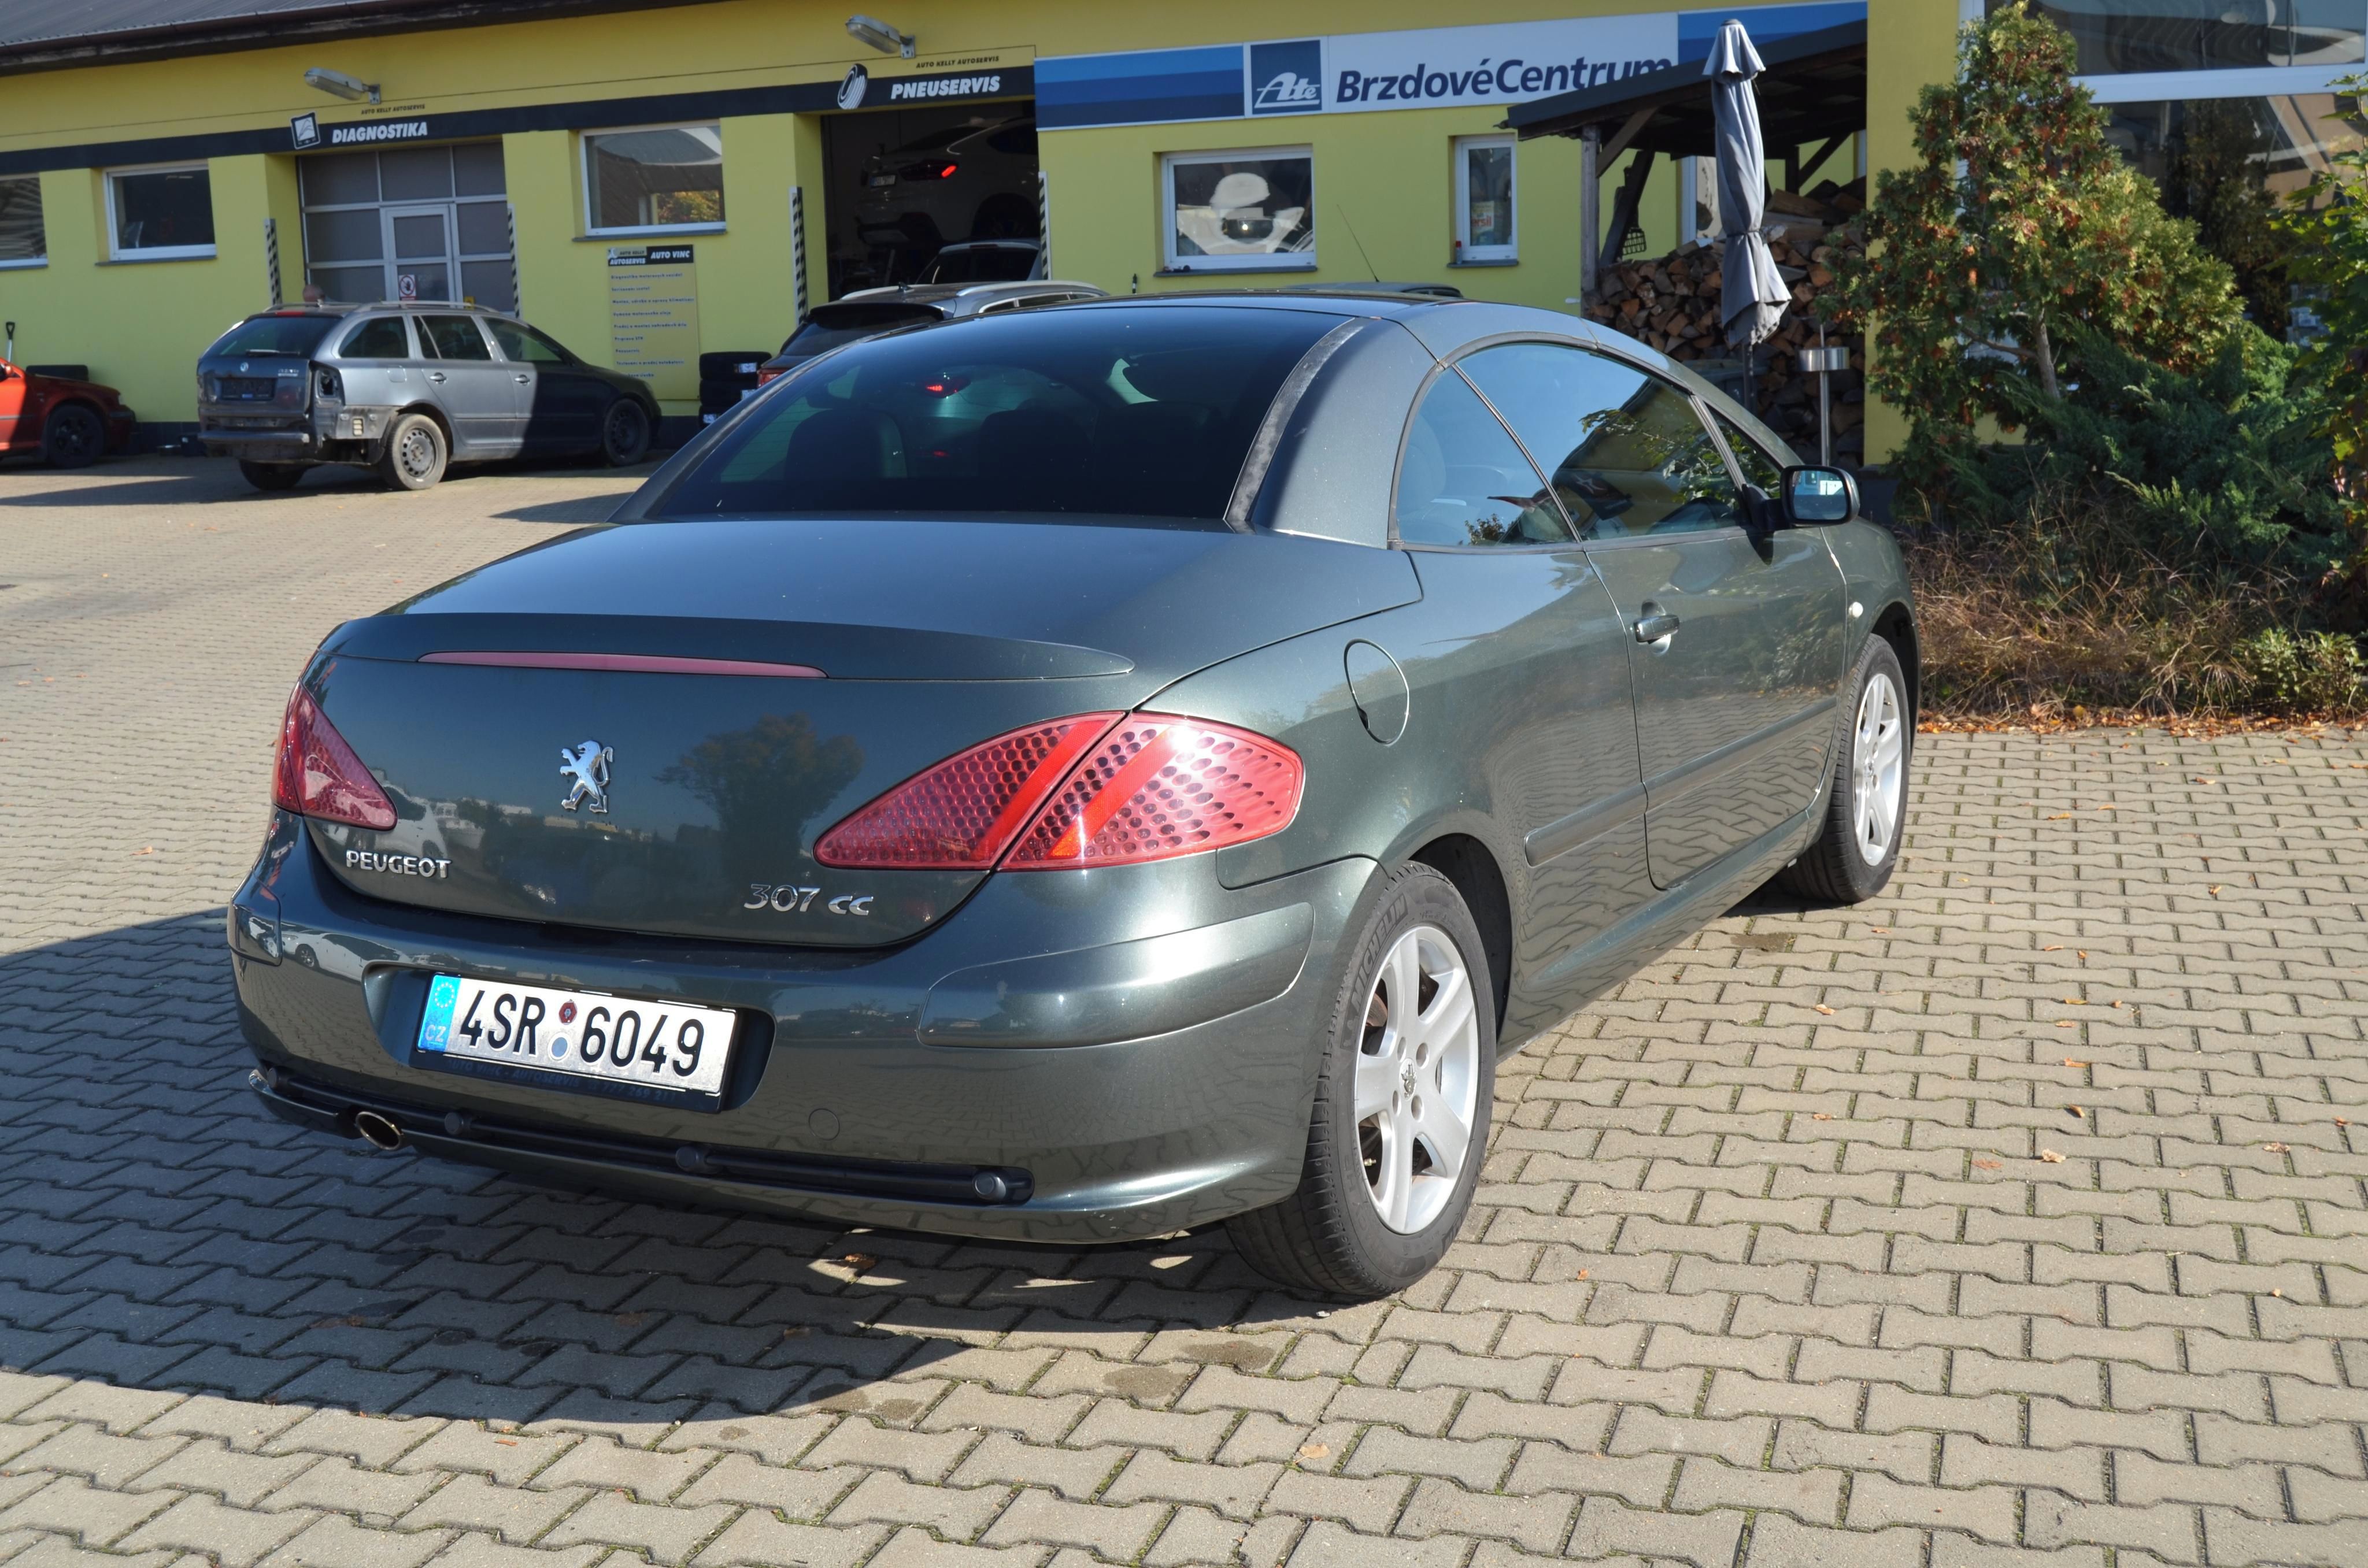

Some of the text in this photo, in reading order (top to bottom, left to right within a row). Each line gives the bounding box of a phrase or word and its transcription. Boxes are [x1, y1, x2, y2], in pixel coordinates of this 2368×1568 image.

[957, 56, 999, 65] AUTOSERVIS
[890, 76, 1000, 99] PNEUSERVIS
[393, 104, 425, 112] AUTOSERVIS
[332, 122, 427, 143] DIAGNOSTIKA
[346, 850, 452, 878] PEUGEOT
[743, 884, 821, 911] 307
[1351, 894, 1408, 1011] MICHELIN
[425, 1024, 446, 1043] CZ
[460, 990, 704, 1077] 4SR 6049
